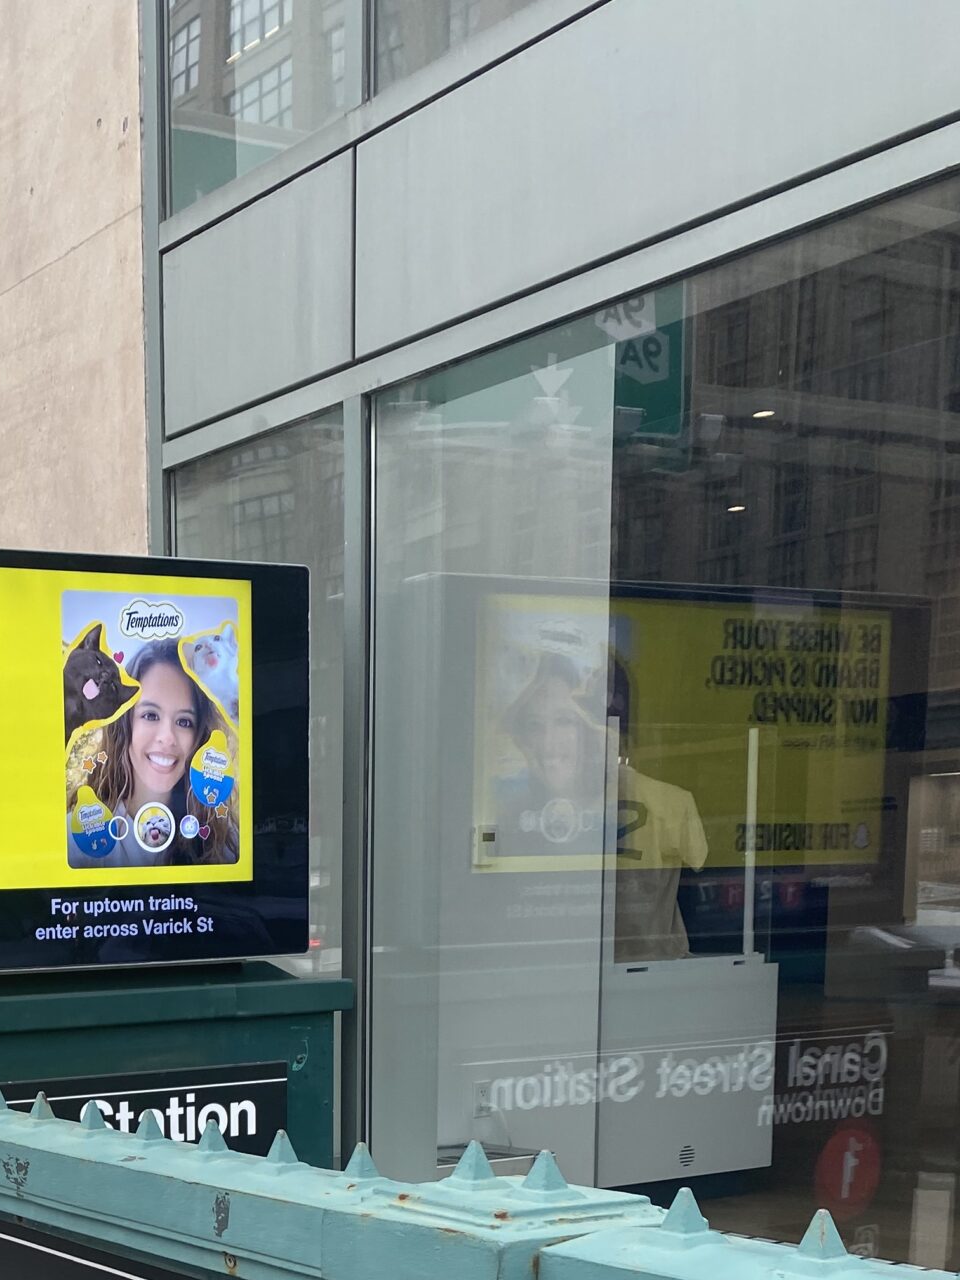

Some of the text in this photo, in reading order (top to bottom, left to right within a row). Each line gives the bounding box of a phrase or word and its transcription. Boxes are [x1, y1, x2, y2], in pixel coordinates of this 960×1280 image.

[126, 611, 180, 633] Temptations
[51, 894, 199, 917] For uptown trains,
[35, 917, 214, 940] enter across Varick St
